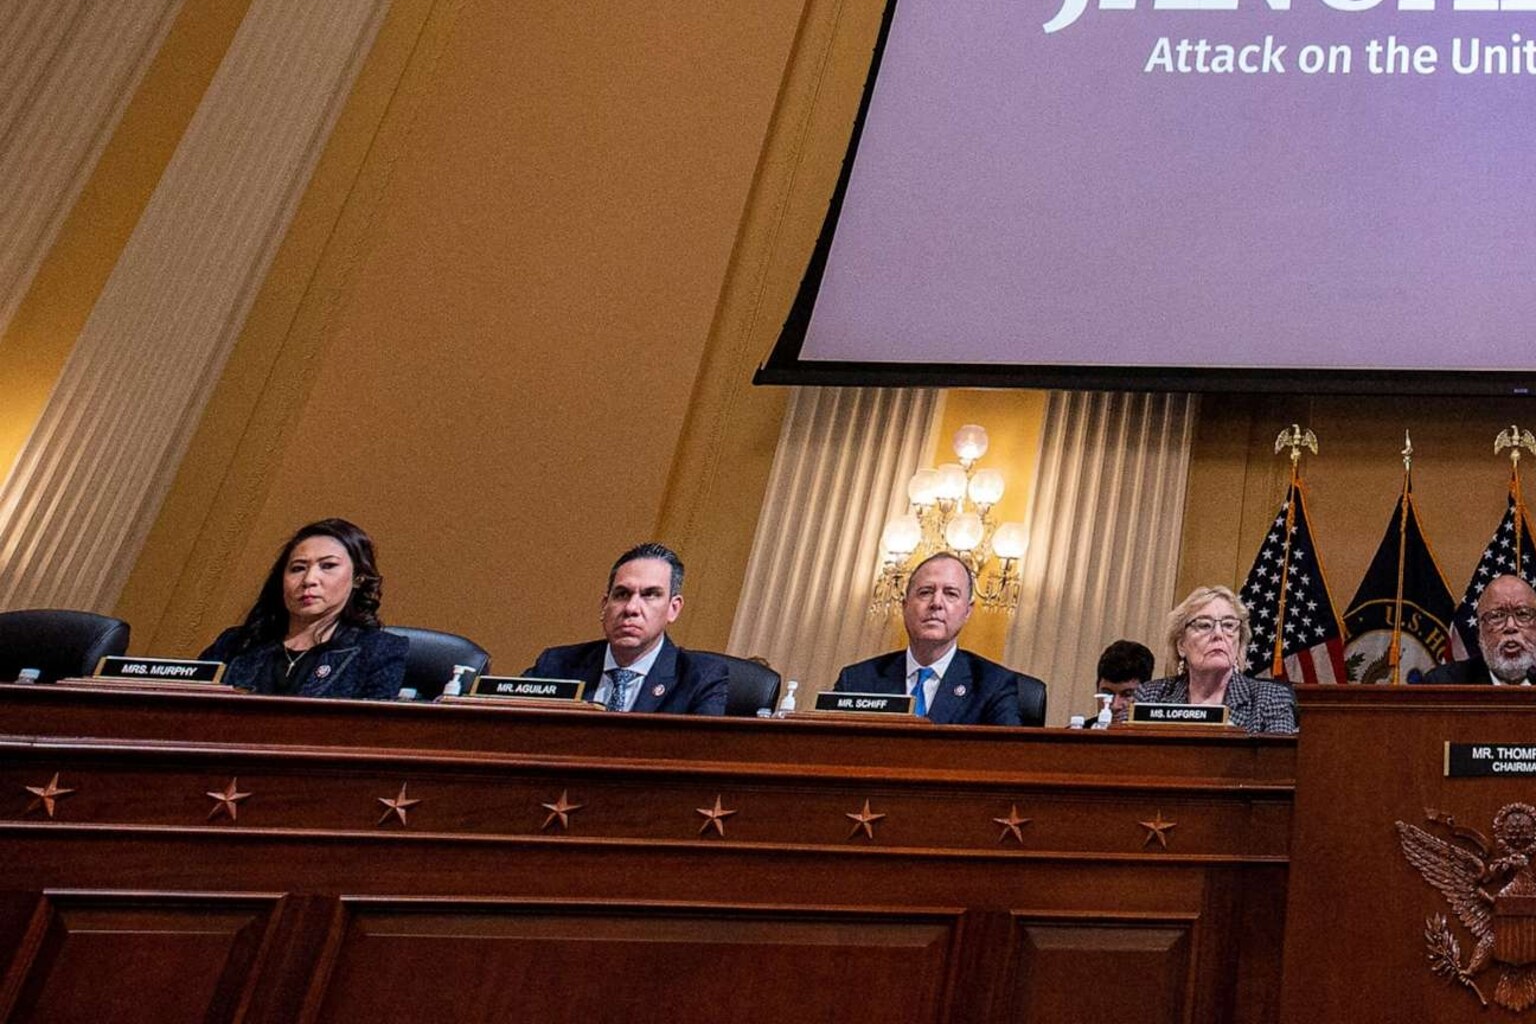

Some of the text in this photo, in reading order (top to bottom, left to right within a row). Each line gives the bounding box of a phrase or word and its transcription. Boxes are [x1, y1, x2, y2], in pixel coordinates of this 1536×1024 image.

[1144, 35, 1287, 73] Attack
[1298, 45, 1351, 74] on
[1365, 36, 1438, 74] the
[121, 664, 198, 677] MRS. MURPHY
[496, 682, 557, 694] MR. AGUILAR
[837, 698, 888, 709] MR. SCHIFF
[1150, 708, 1207, 719] MS. LOFGREN
[1472, 747, 1494, 760] MR.
